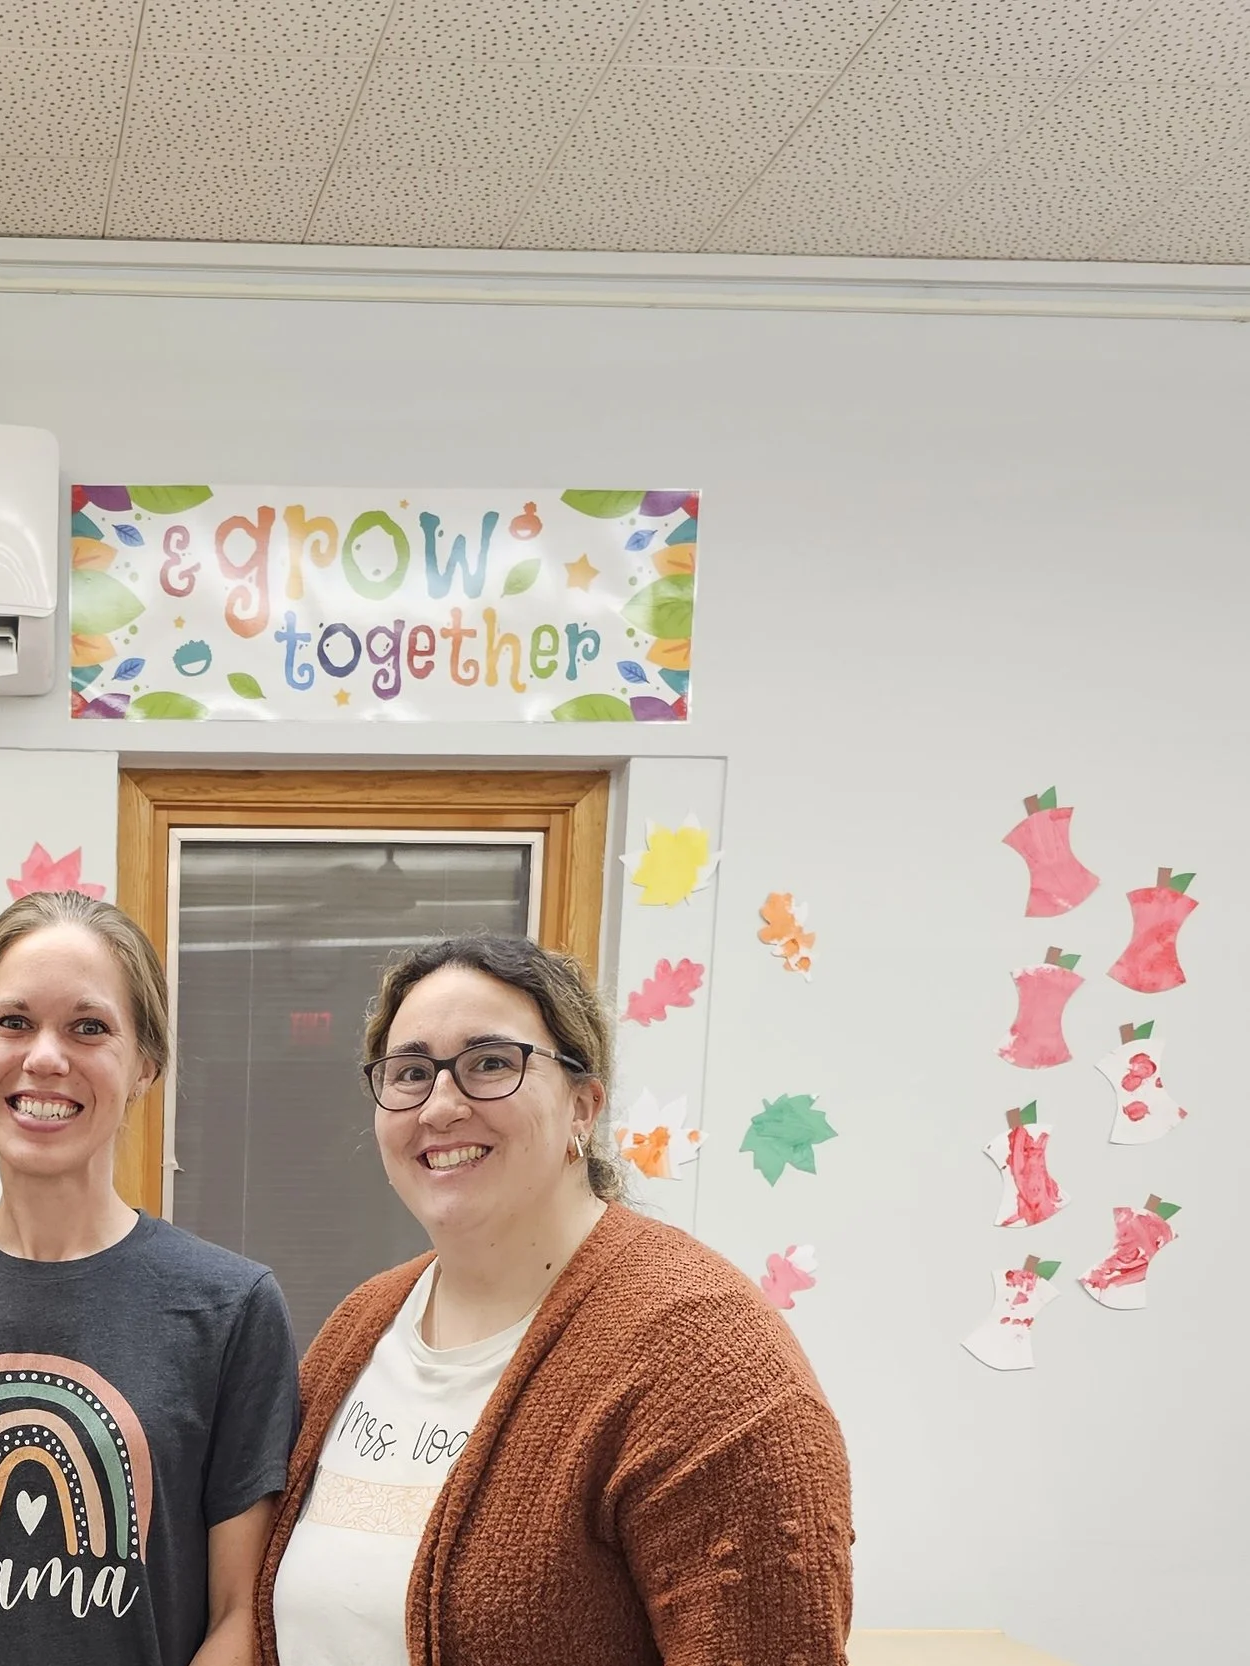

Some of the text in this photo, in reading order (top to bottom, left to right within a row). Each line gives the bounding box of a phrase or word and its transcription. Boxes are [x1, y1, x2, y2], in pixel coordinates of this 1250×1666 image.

[159, 505, 499, 638] & grow
[274, 607, 601, 700] together
[337, 1401, 397, 1462] Mrs.
